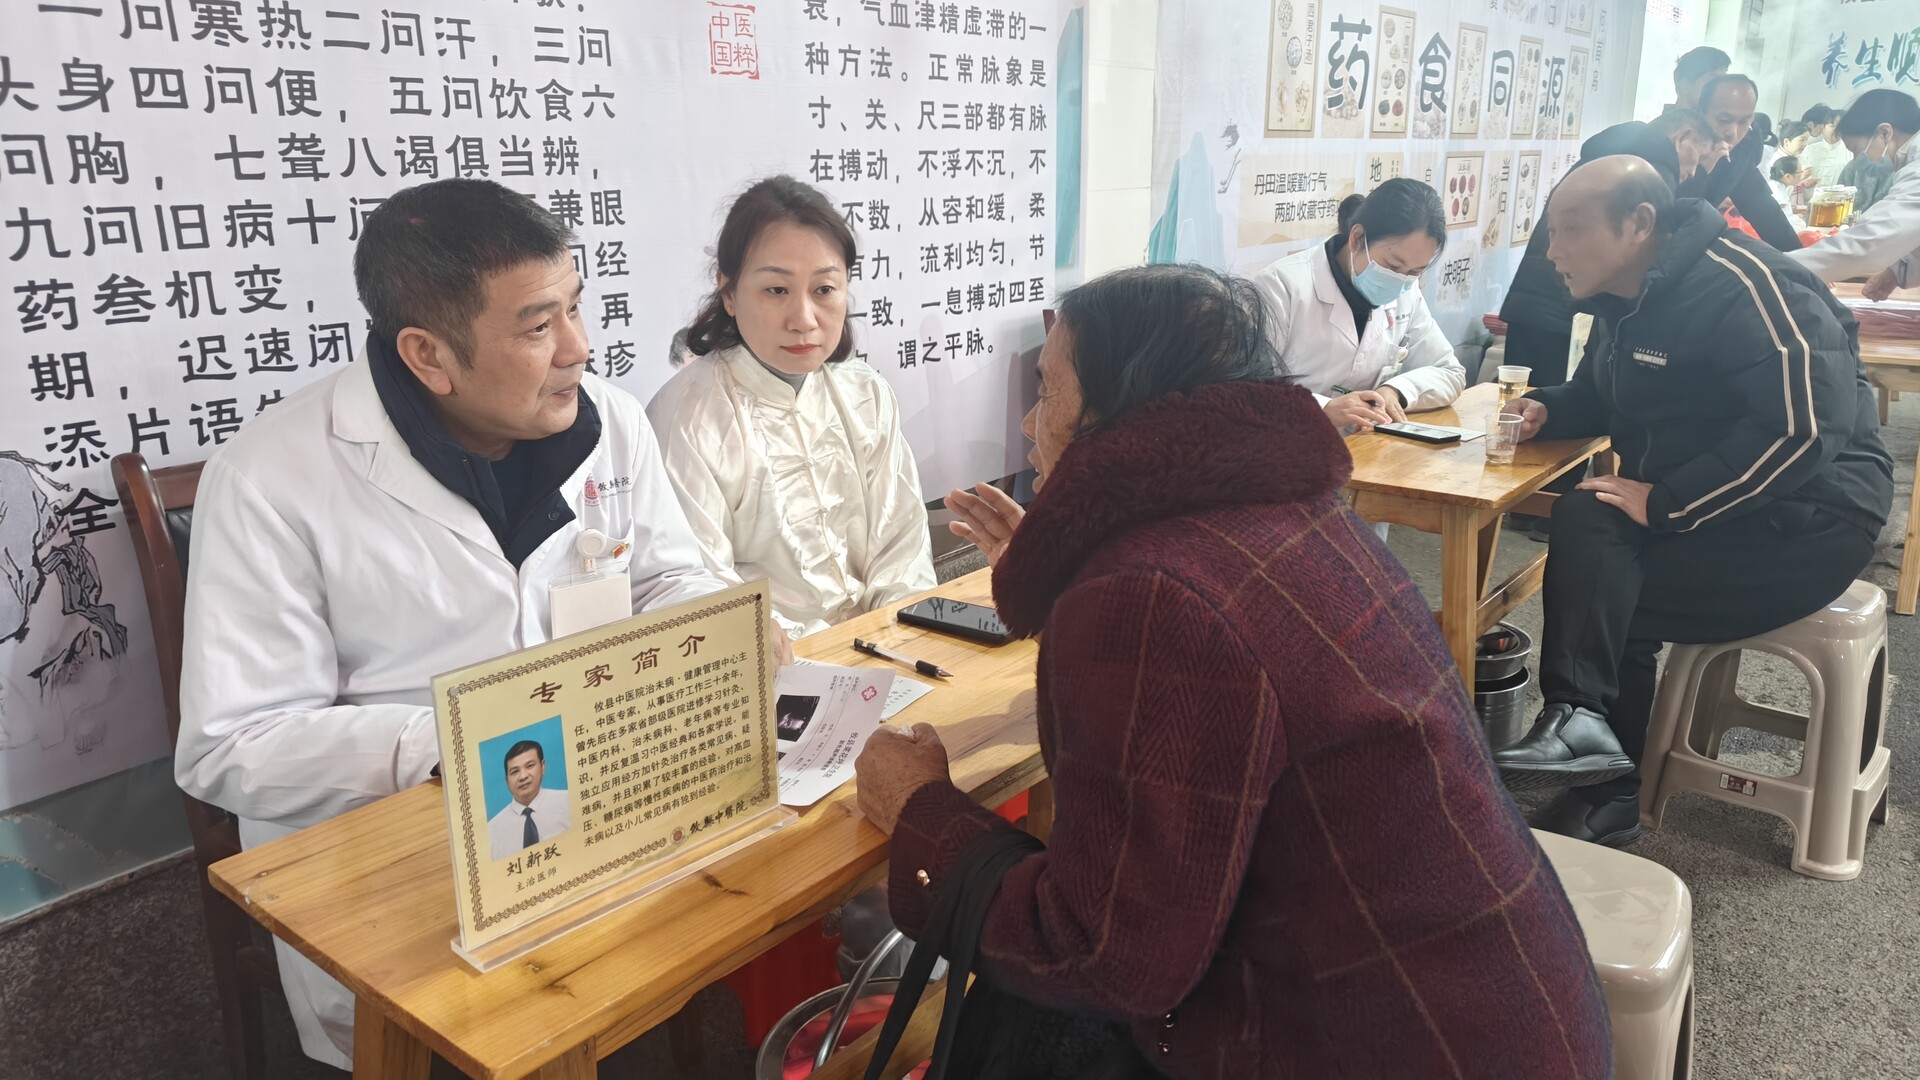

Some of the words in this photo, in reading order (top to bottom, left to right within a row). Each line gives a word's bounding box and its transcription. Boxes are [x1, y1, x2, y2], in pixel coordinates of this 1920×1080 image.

[1328, 13, 1566, 119] 药食同源
[1254, 171, 1328, 196] 丹田温暖勤行气
[1442, 257, 1470, 287] 决明子
[600, 291, 633, 330] 再
[55, 487, 120, 537] 全
[530, 634, 706, 703] 专家简介
[507, 843, 562, 876] 刘新跃
[515, 866, 557, 893] 主治医师
